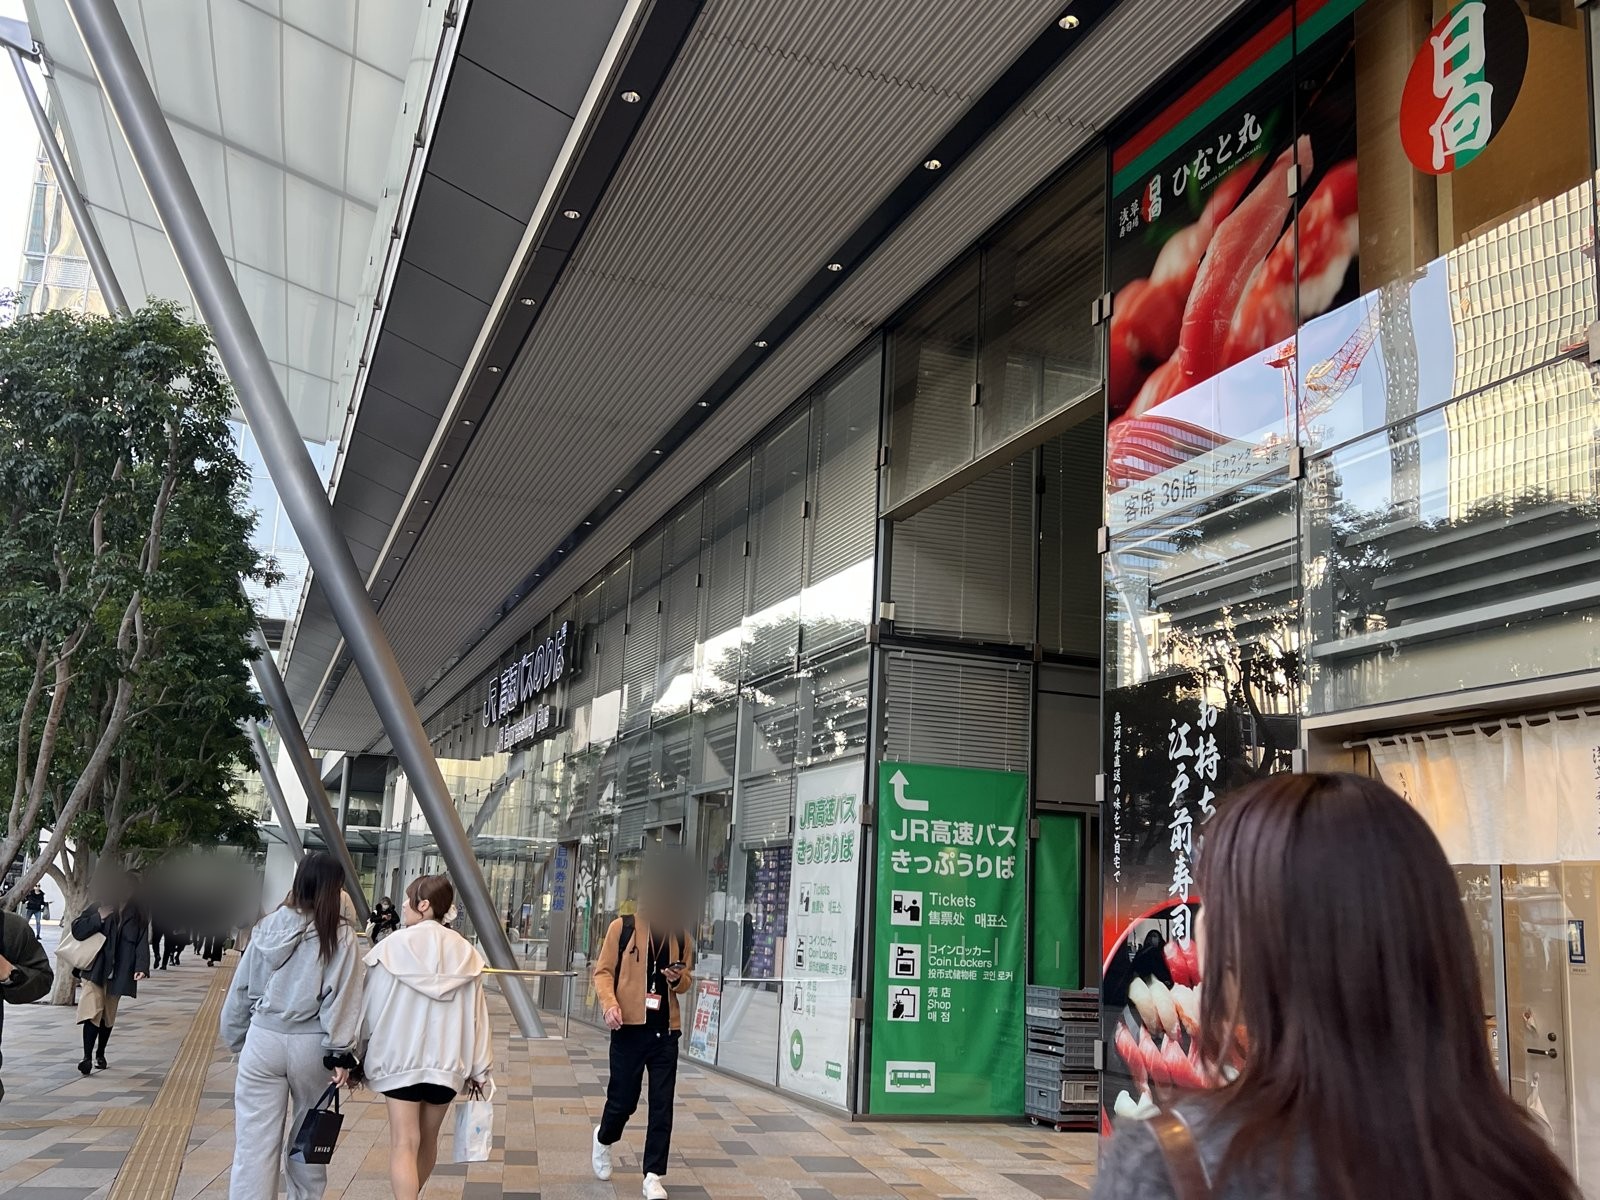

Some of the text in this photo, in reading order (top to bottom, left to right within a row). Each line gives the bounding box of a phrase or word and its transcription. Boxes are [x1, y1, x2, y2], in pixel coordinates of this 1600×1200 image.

[1172, 112, 1262, 196] ひなと丸
[1124, 469, 1199, 523] 客席 36席
[890, 818, 1017, 848] JR高速バス
[1167, 718, 1194, 951] 江戸前寿司
[890, 848, 1016, 880] きっぷうりば
[929, 891, 976, 908] Tickets
[974, 912, 1008, 929] 매표소
[928, 944, 992, 957] コインロッカー
[928, 955, 993, 968] Coin Lockers
[982, 970, 996, 981] 코인
[997, 971, 1014, 982] 로커
[927, 998, 952, 1012] Shop
